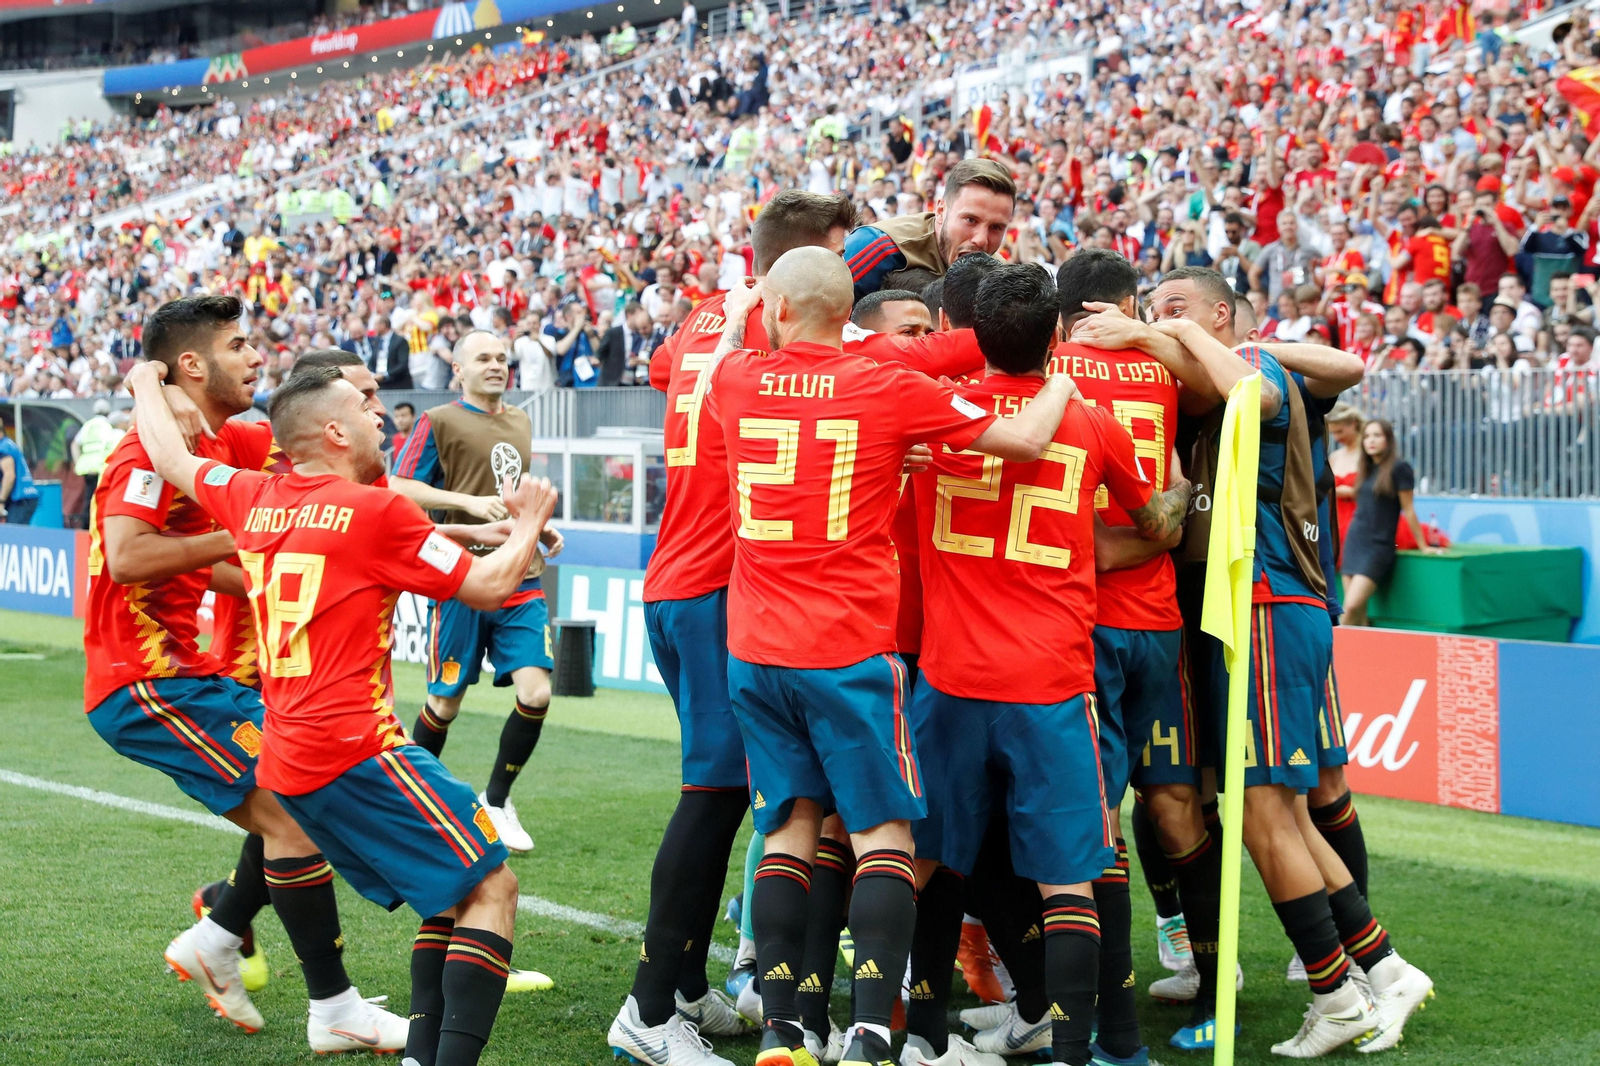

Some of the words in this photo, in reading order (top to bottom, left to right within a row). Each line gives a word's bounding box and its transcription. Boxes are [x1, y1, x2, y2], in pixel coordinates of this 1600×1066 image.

[758, 372, 835, 398] SILVA
[1045, 356, 1110, 381] DIEGO
[667, 353, 714, 467] 3
[737, 418, 859, 541] 21
[932, 442, 1088, 569] 22
[294, 503, 354, 533] ALBA
[238, 549, 326, 678] 18
[1455, 638, 1475, 709] ВРЕДИТ
[1474, 639, 1498, 734] ЗДОРОВЬЮ
[1456, 713, 1476, 809] АЛКОГОЛЯ
[1475, 737, 1496, 812] ВАШЕМУ
[764, 973, 794, 981] adidas
[798, 985, 823, 993] adidas
[855, 972, 883, 980] adidas
